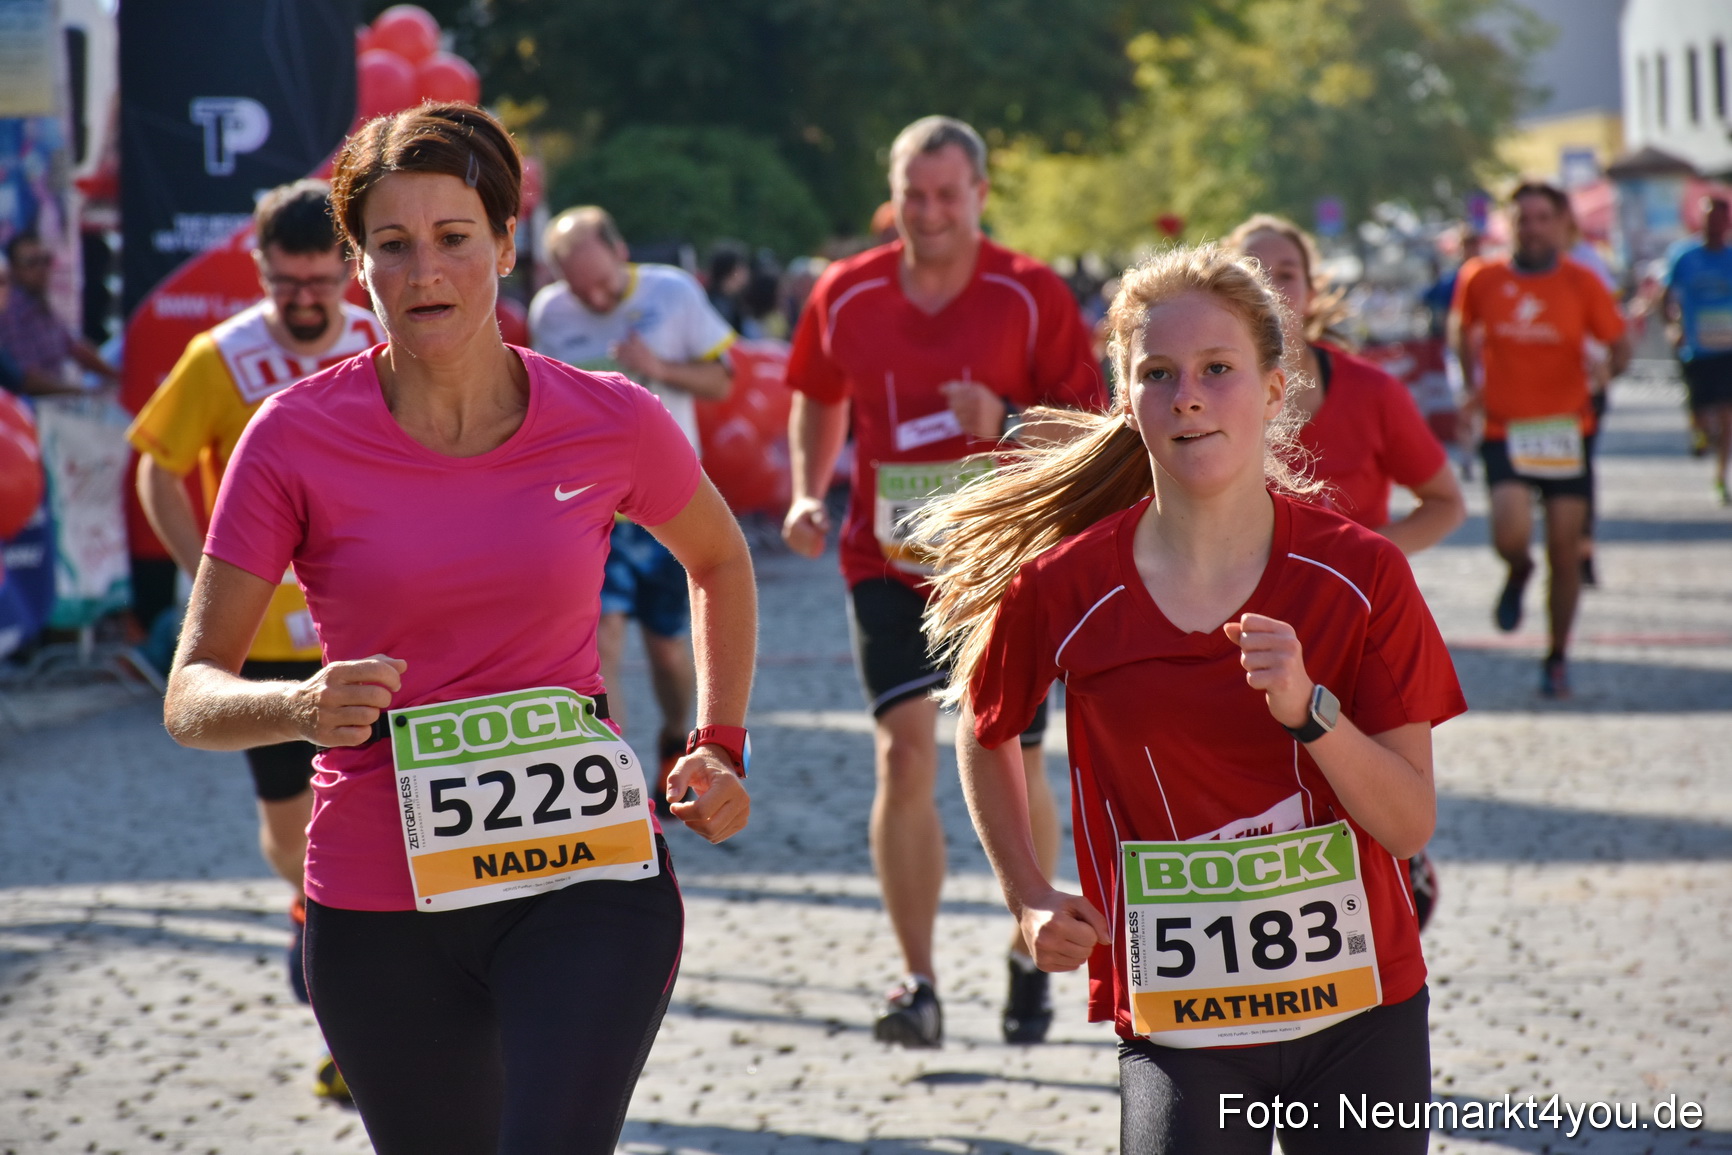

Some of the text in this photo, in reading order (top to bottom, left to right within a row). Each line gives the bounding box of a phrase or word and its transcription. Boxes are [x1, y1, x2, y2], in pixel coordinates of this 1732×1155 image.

[411, 697, 596, 758] BOCK
[429, 754, 619, 837] 5229
[472, 841, 596, 879] NADJA
[1140, 835, 1336, 894] BOCK
[1156, 900, 1343, 978] 5183
[1173, 982, 1339, 1024] KATHRIN
